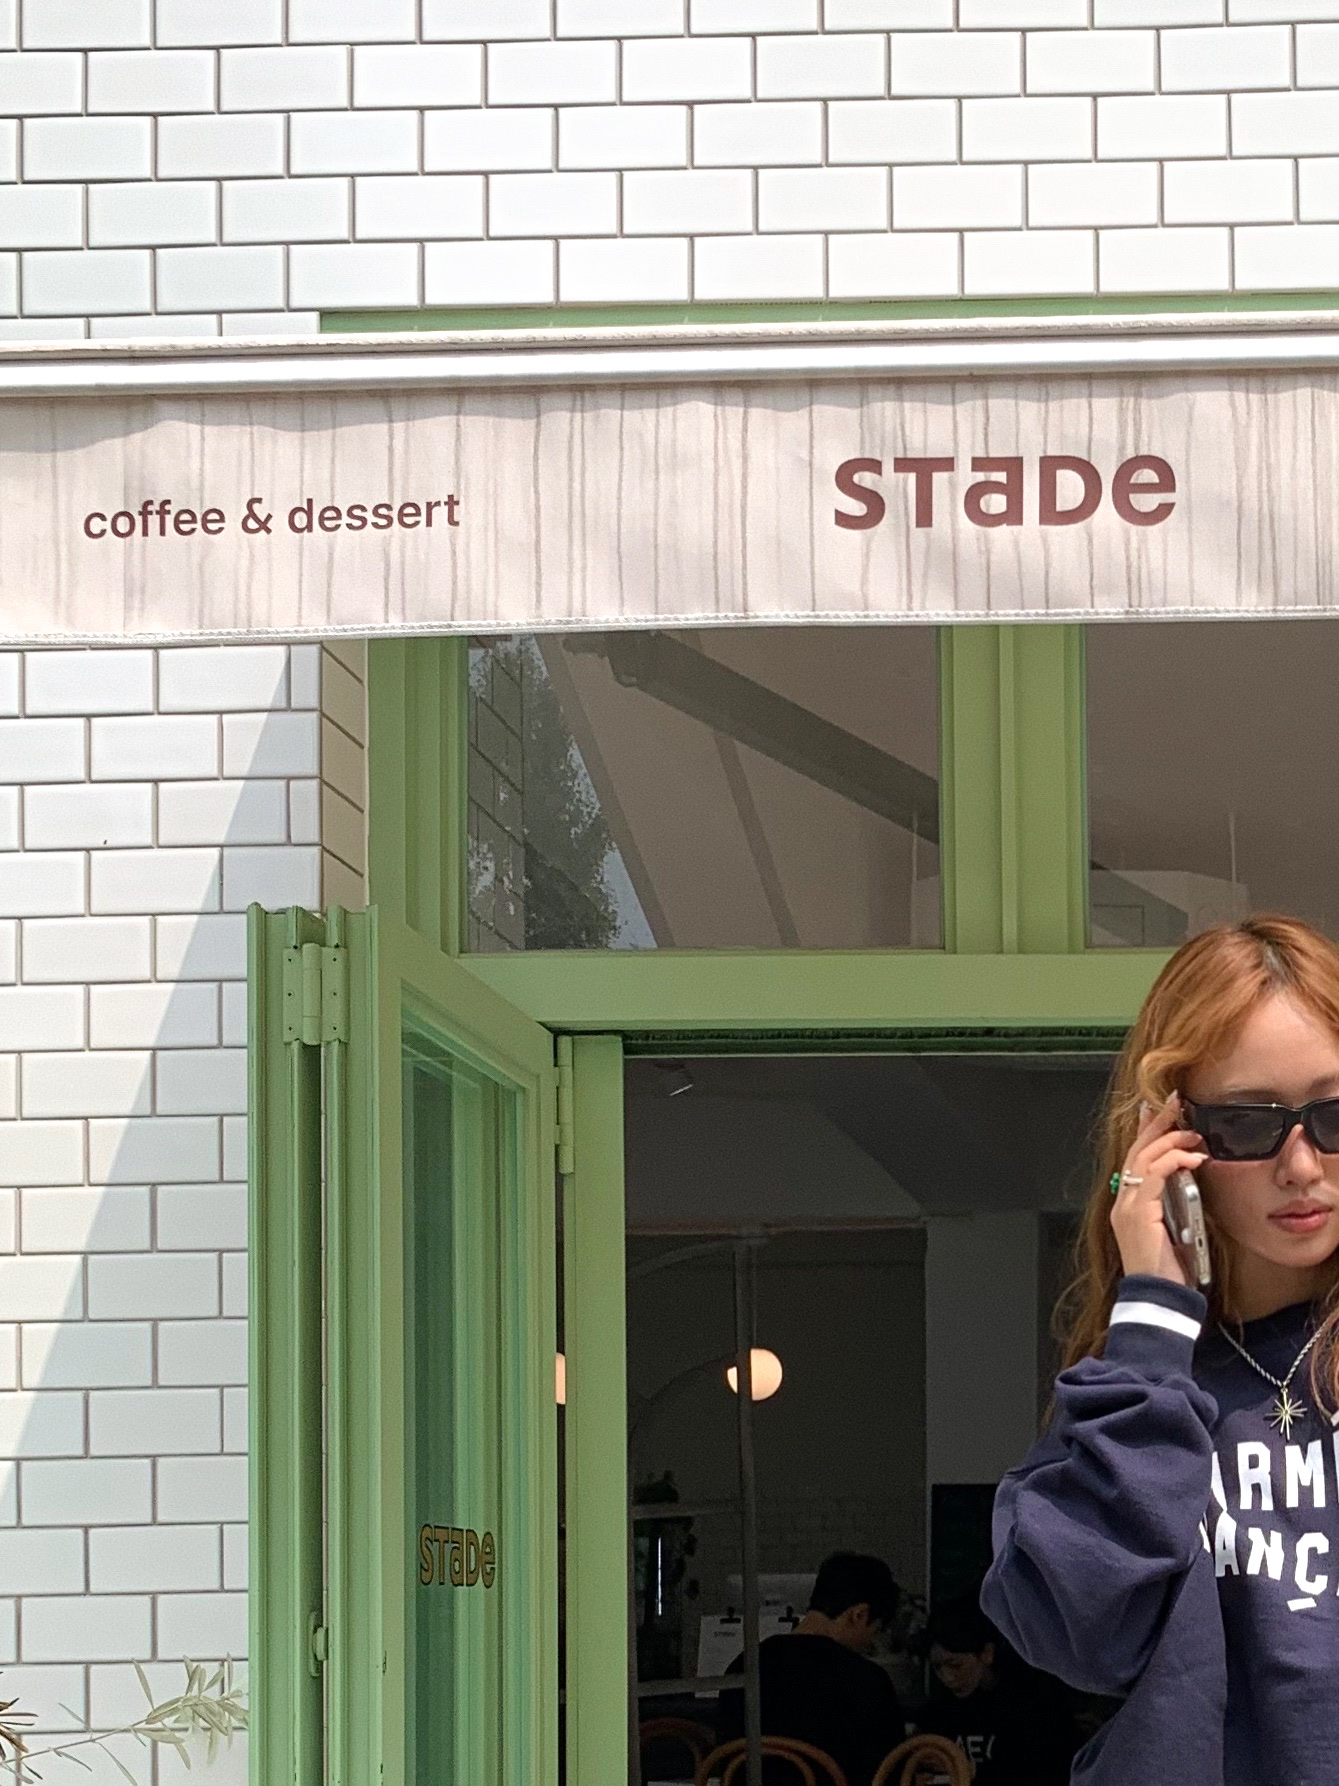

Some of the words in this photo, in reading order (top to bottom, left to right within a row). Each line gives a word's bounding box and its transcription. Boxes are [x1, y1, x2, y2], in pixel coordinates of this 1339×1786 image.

[82, 497, 226, 540] coffee
[241, 498, 273, 534] &
[287, 493, 461, 533] dessert
